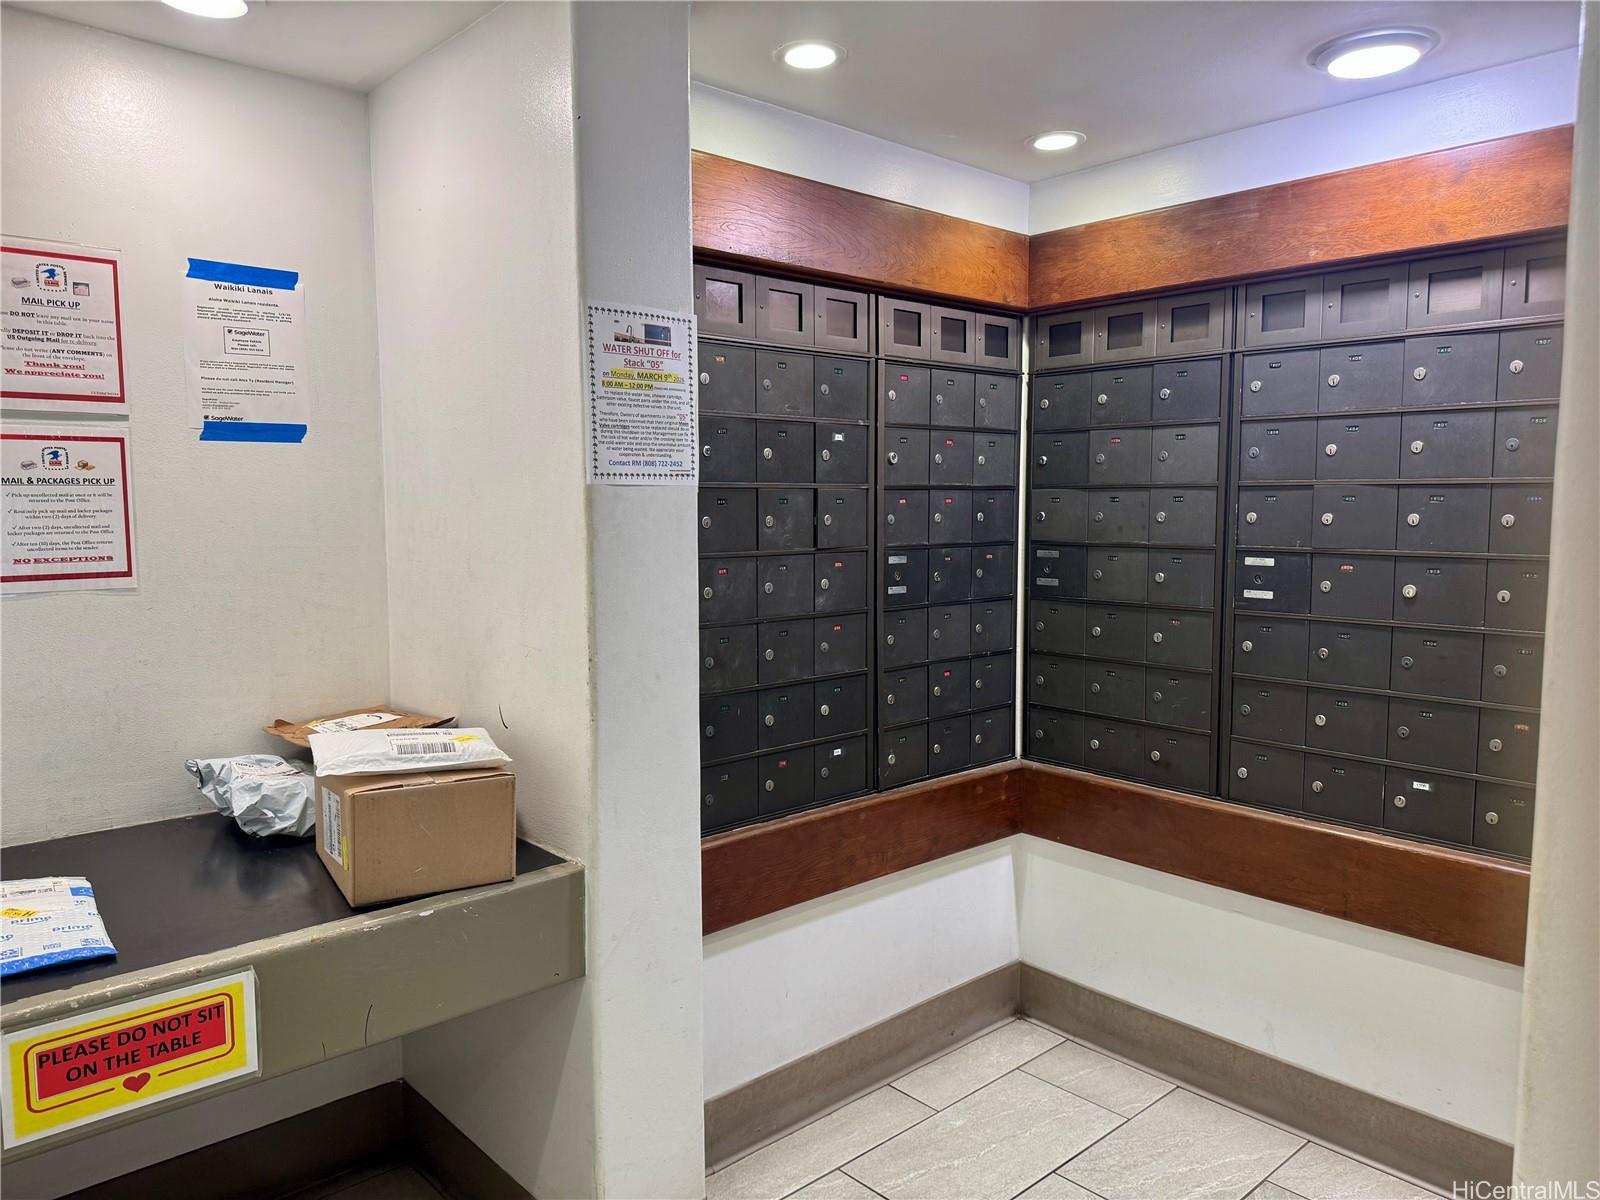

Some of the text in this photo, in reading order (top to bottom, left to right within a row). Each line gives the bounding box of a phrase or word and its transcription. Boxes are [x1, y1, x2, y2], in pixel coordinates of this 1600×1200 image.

[214, 283, 272, 294] Waikiki Lanais
[21, 297, 44, 306] MAIL
[603, 343, 681, 358] WATER SHUT OFF for
[624, 358, 644, 367] Stack
[24, 370, 80, 378] appreciate
[611, 370, 636, 380] Monday,
[637, 372, 662, 381] MARCH
[642, 460, 656, 468] (808)
[33, 556, 114, 564] EXCEPTIONS
[38, 1003, 224, 1069] PLEASE DO NOT SIT
[66, 1031, 202, 1082] ON THE TABLE
